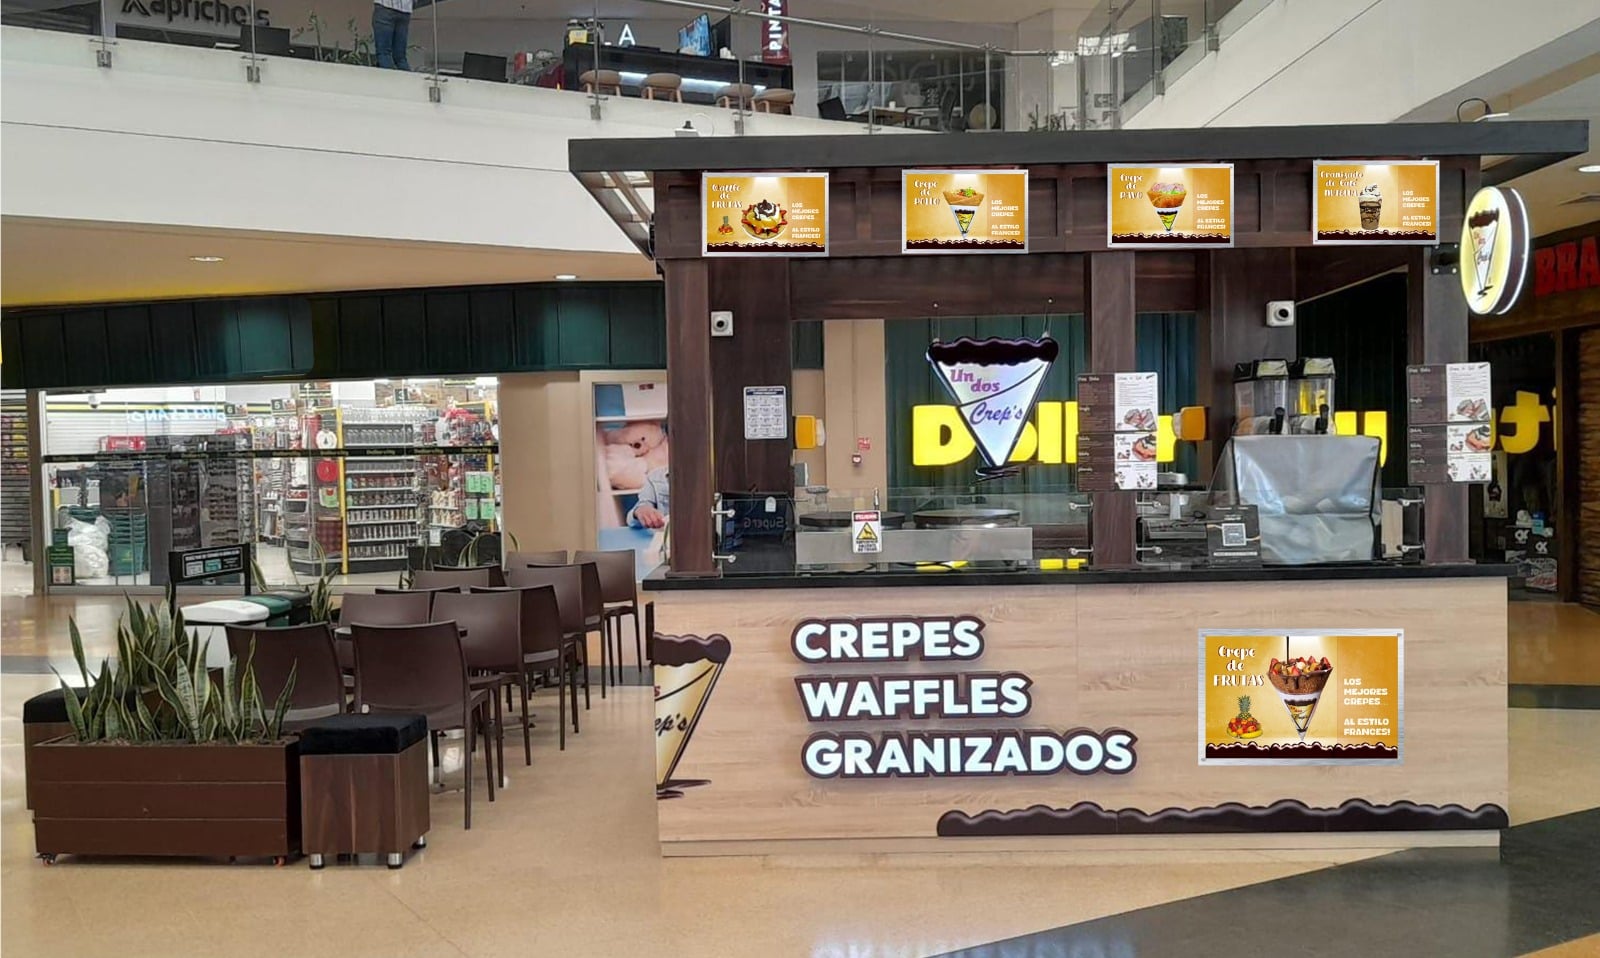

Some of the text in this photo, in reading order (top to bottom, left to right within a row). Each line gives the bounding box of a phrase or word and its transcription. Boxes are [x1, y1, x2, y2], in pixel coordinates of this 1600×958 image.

[950, 369, 974, 383] Un
[970, 378, 1000, 392] dos
[970, 402, 1024, 425] Crep's
[794, 619, 981, 660] CREPES
[1218, 645, 1255, 660] Crepe
[1226, 660, 1244, 671] de
[1214, 674, 1265, 687] FRUTAS
[1344, 678, 1362, 686] LOS
[800, 676, 1029, 718] WAFFLES
[1344, 688, 1388, 696] MEJORES
[1344, 698, 1381, 706] CREPES
[1344, 718, 1390, 726] AL ESTILO
[1344, 728, 1391, 736] FRANCES!
[804, 733, 1136, 776] GRANIZADOS
